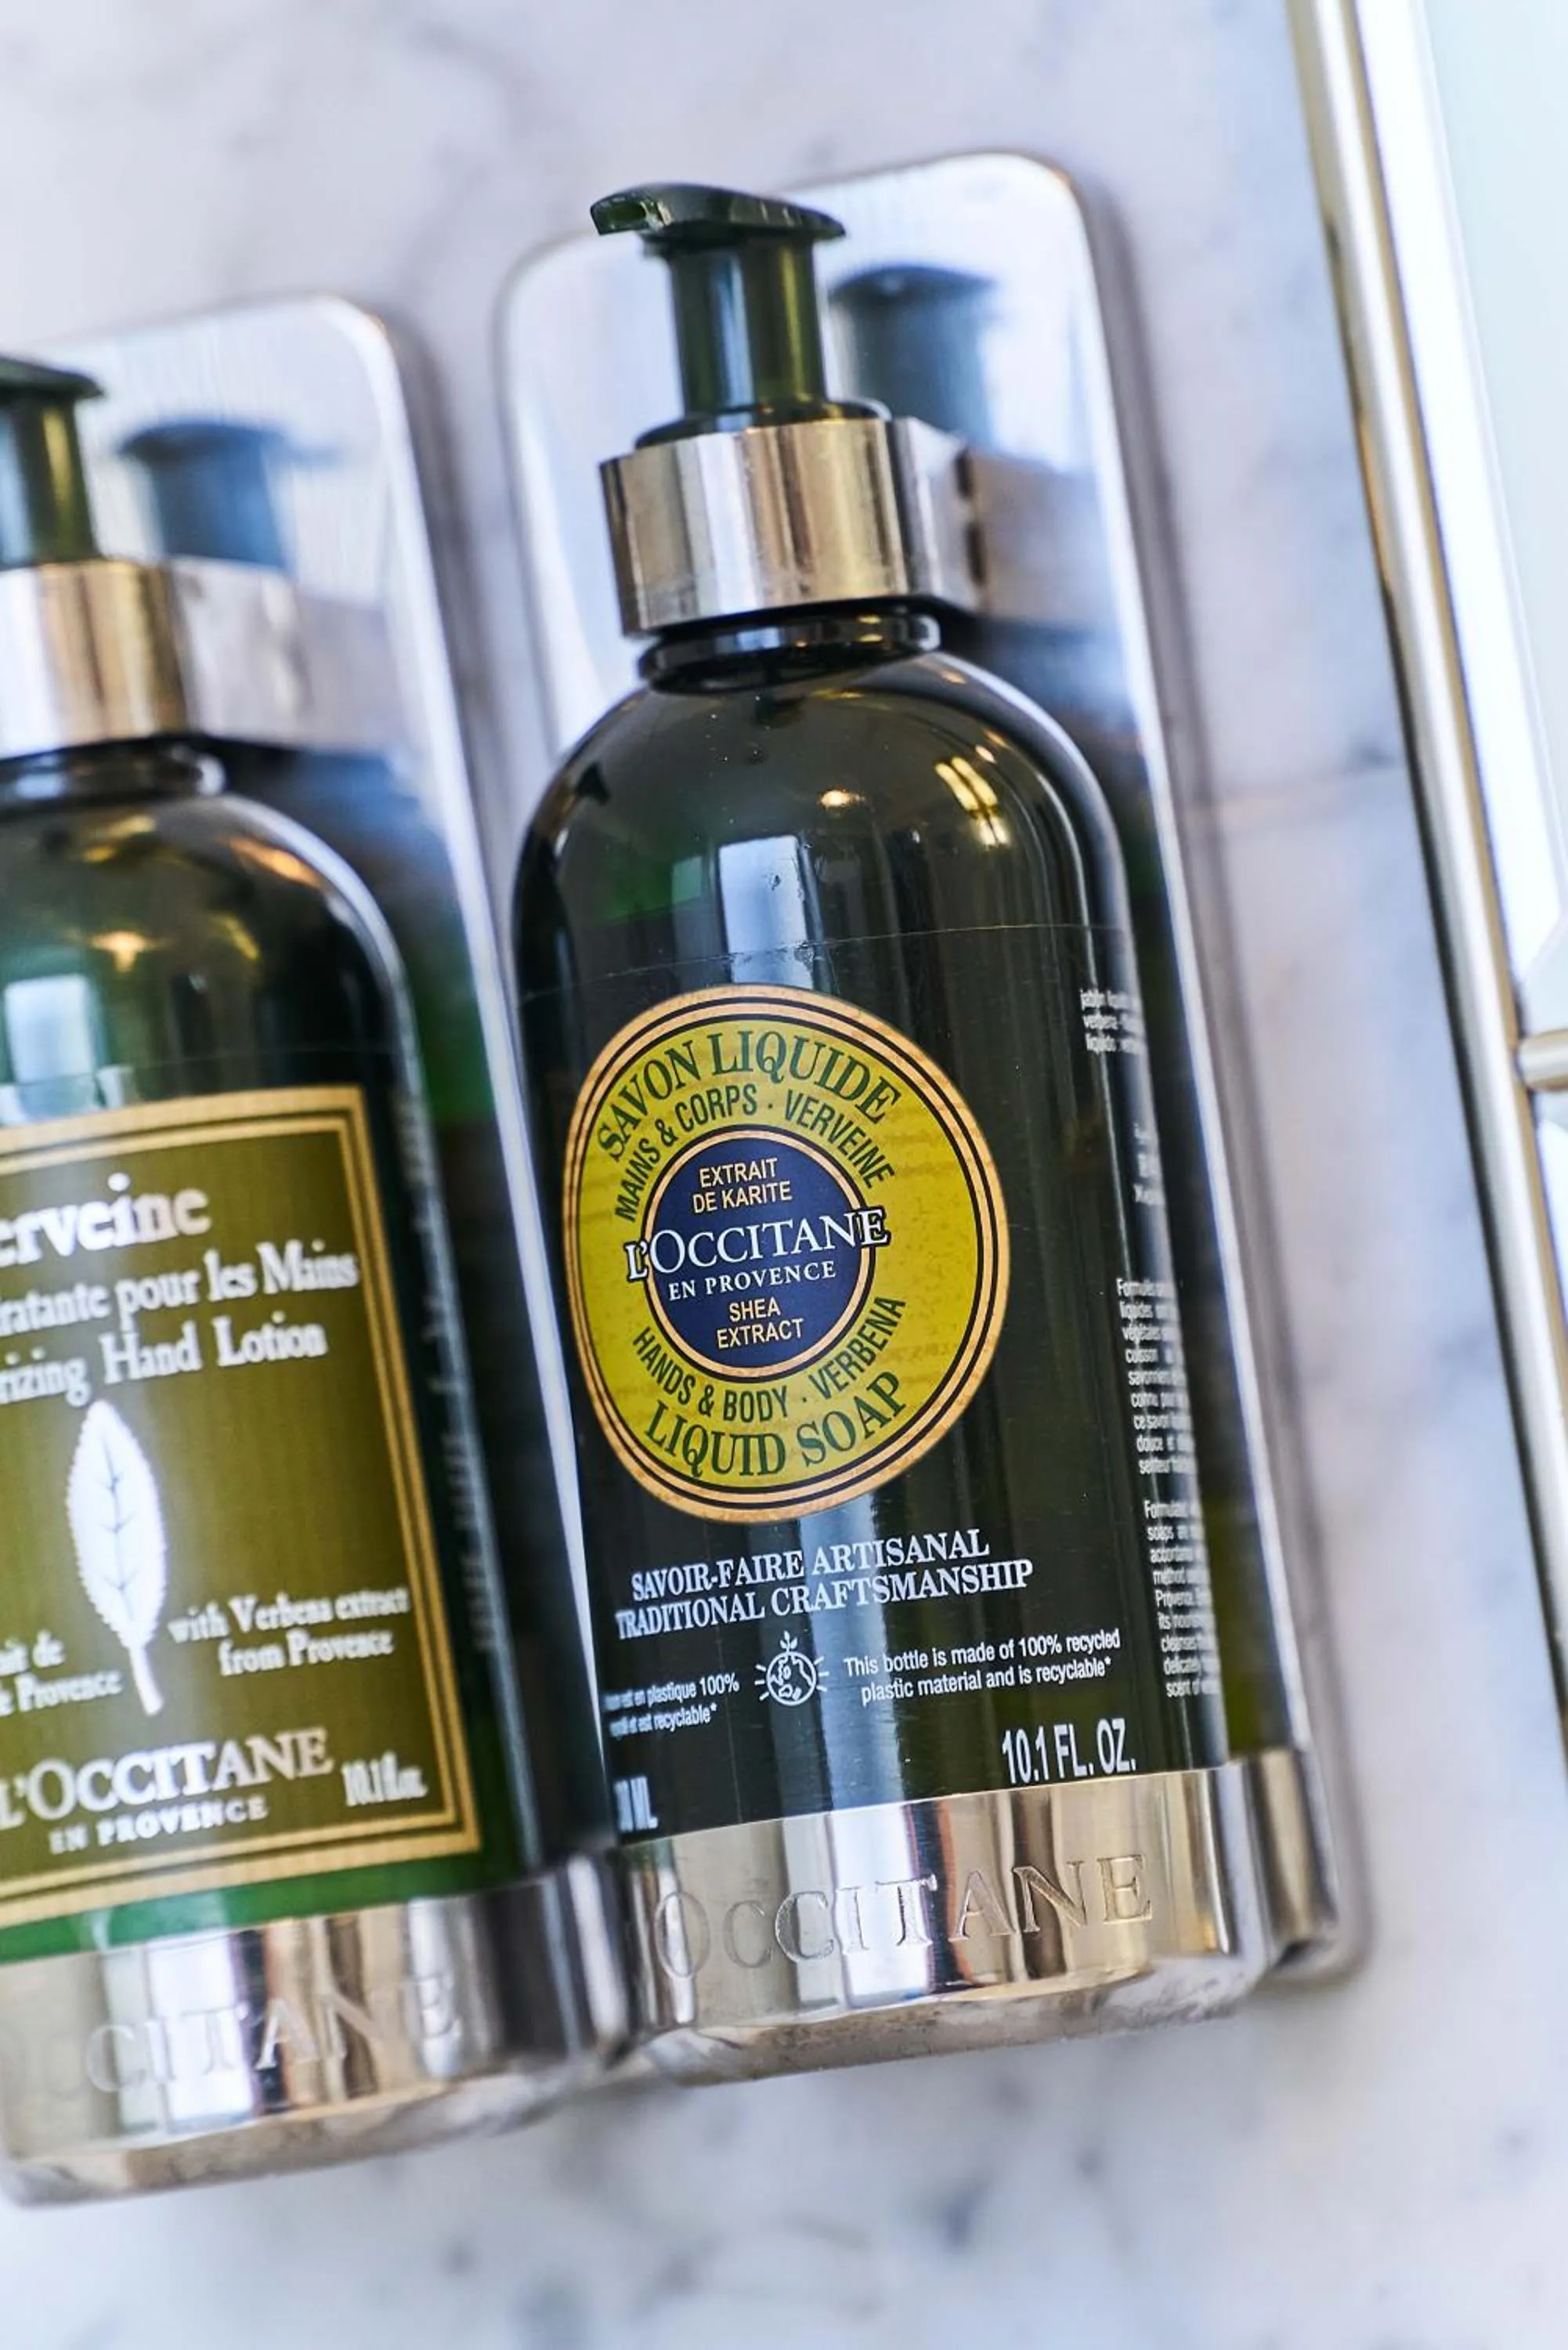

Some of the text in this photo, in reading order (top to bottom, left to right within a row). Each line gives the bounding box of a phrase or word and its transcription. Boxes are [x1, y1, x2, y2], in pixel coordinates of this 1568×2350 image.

[598, 1030, 902, 1163] SAVON LIQUIDE
[614, 1083, 895, 1223] MAINS & CORPS VERVEINE
[699, 1157, 779, 1188] EXTRAIT
[692, 1180, 793, 1214] DE KARITE
[628, 1208, 889, 1280] L'OCCITANE
[115, 1270, 200, 1332] pour
[203, 1249, 257, 1303] les
[668, 1260, 836, 1301] EN PROVENCE
[728, 1296, 781, 1323] SHEA
[99, 1320, 203, 1385] Hand
[211, 1311, 329, 1368] Lotion
[632, 1296, 906, 1423] HANDS & BODY VERBENA
[716, 1318, 804, 1350] EXTRACT
[644, 1369, 907, 1477] LIQUID SOAP
[630, 1528, 991, 1602] SAVOIR-FAIRE ARTISANAL
[166, 1600, 230, 1644] with
[614, 1558, 1034, 1640] TRADITIONAL CRAFTSMANSHIP
[218, 1639, 287, 1677] from
[843, 1627, 1122, 1678] This bottle is made of 100% recycled
[647, 1681, 698, 1709] plastique
[699, 1671, 741, 1697] 100%
[861, 1676, 915, 1708] plastic
[917, 1669, 983, 1701] material
[985, 1665, 1017, 1689] and
[1017, 1664, 1033, 1685] is
[1002, 1716, 1137, 1785] 10.1 FL. OZ.
[48, 1795, 270, 1856] EN PROVENCE
